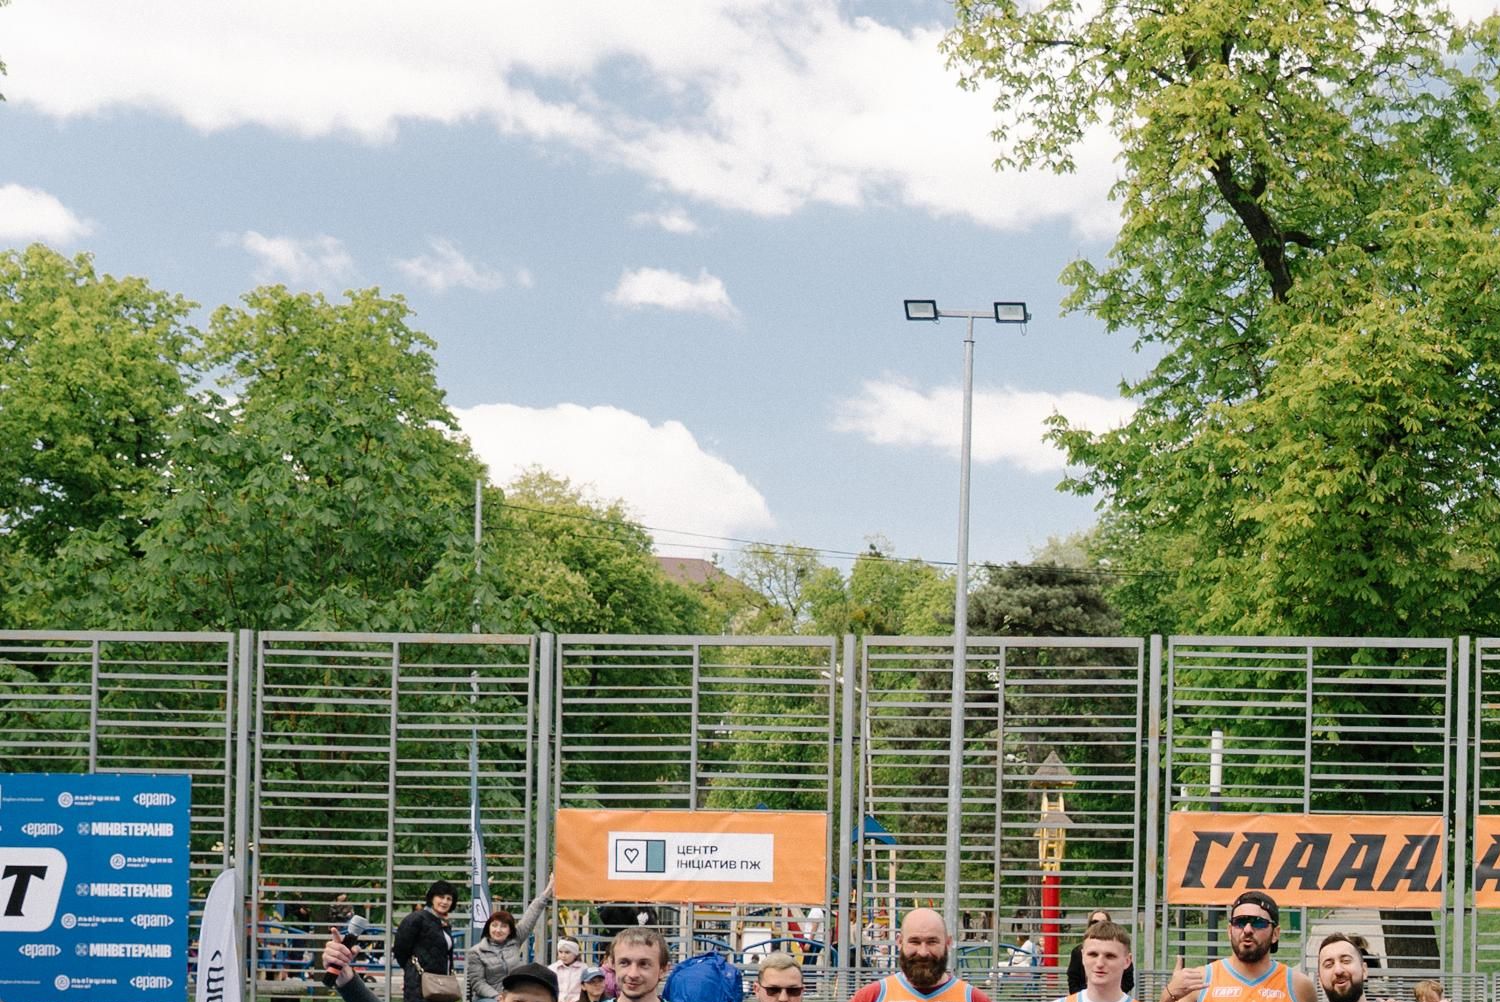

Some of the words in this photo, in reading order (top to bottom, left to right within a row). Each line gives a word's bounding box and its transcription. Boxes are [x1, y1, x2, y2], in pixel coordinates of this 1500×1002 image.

[91, 822, 174, 837] МІНВЕТЕРАНІВ
[677, 845, 718, 856] ЦЕНТР
[676, 859, 737, 871] ІНІЦІАТИВ
[740, 860, 761, 870] ПЖ
[1180, 831, 1442, 892] ГАААА
[90, 883, 173, 898] МІНВЕТЕРАНІВ
[89, 943, 172, 958] МІНВЕТЕРАНІВ
